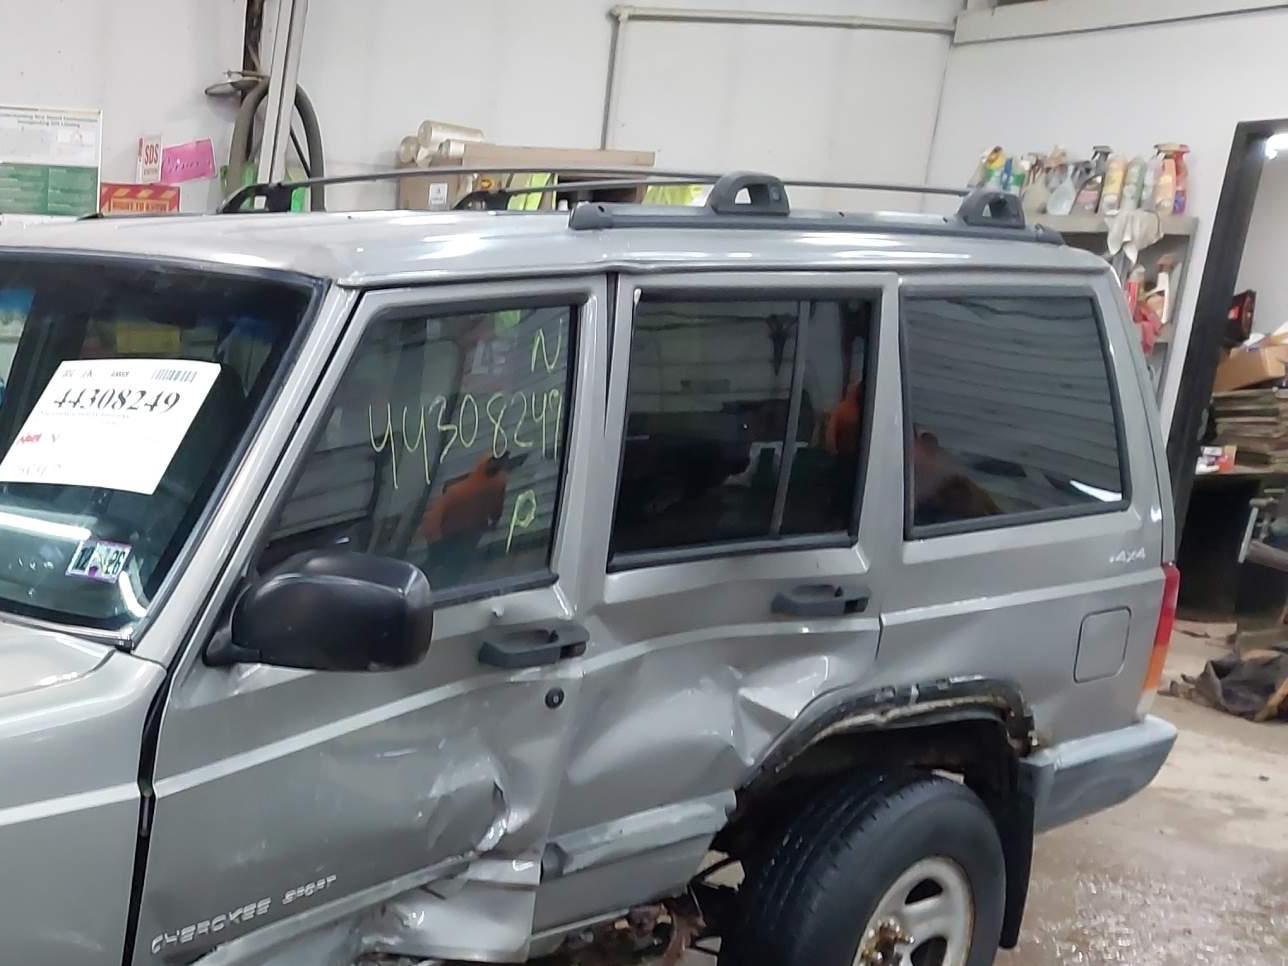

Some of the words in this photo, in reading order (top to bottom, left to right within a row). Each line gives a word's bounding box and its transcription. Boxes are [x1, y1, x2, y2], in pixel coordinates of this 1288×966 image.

[144, 143, 159, 166] SDS
[53, 388, 182, 413] 44308249
[368, 388, 563, 490] 44308249
[151, 897, 272, 955] CHEROKEE
